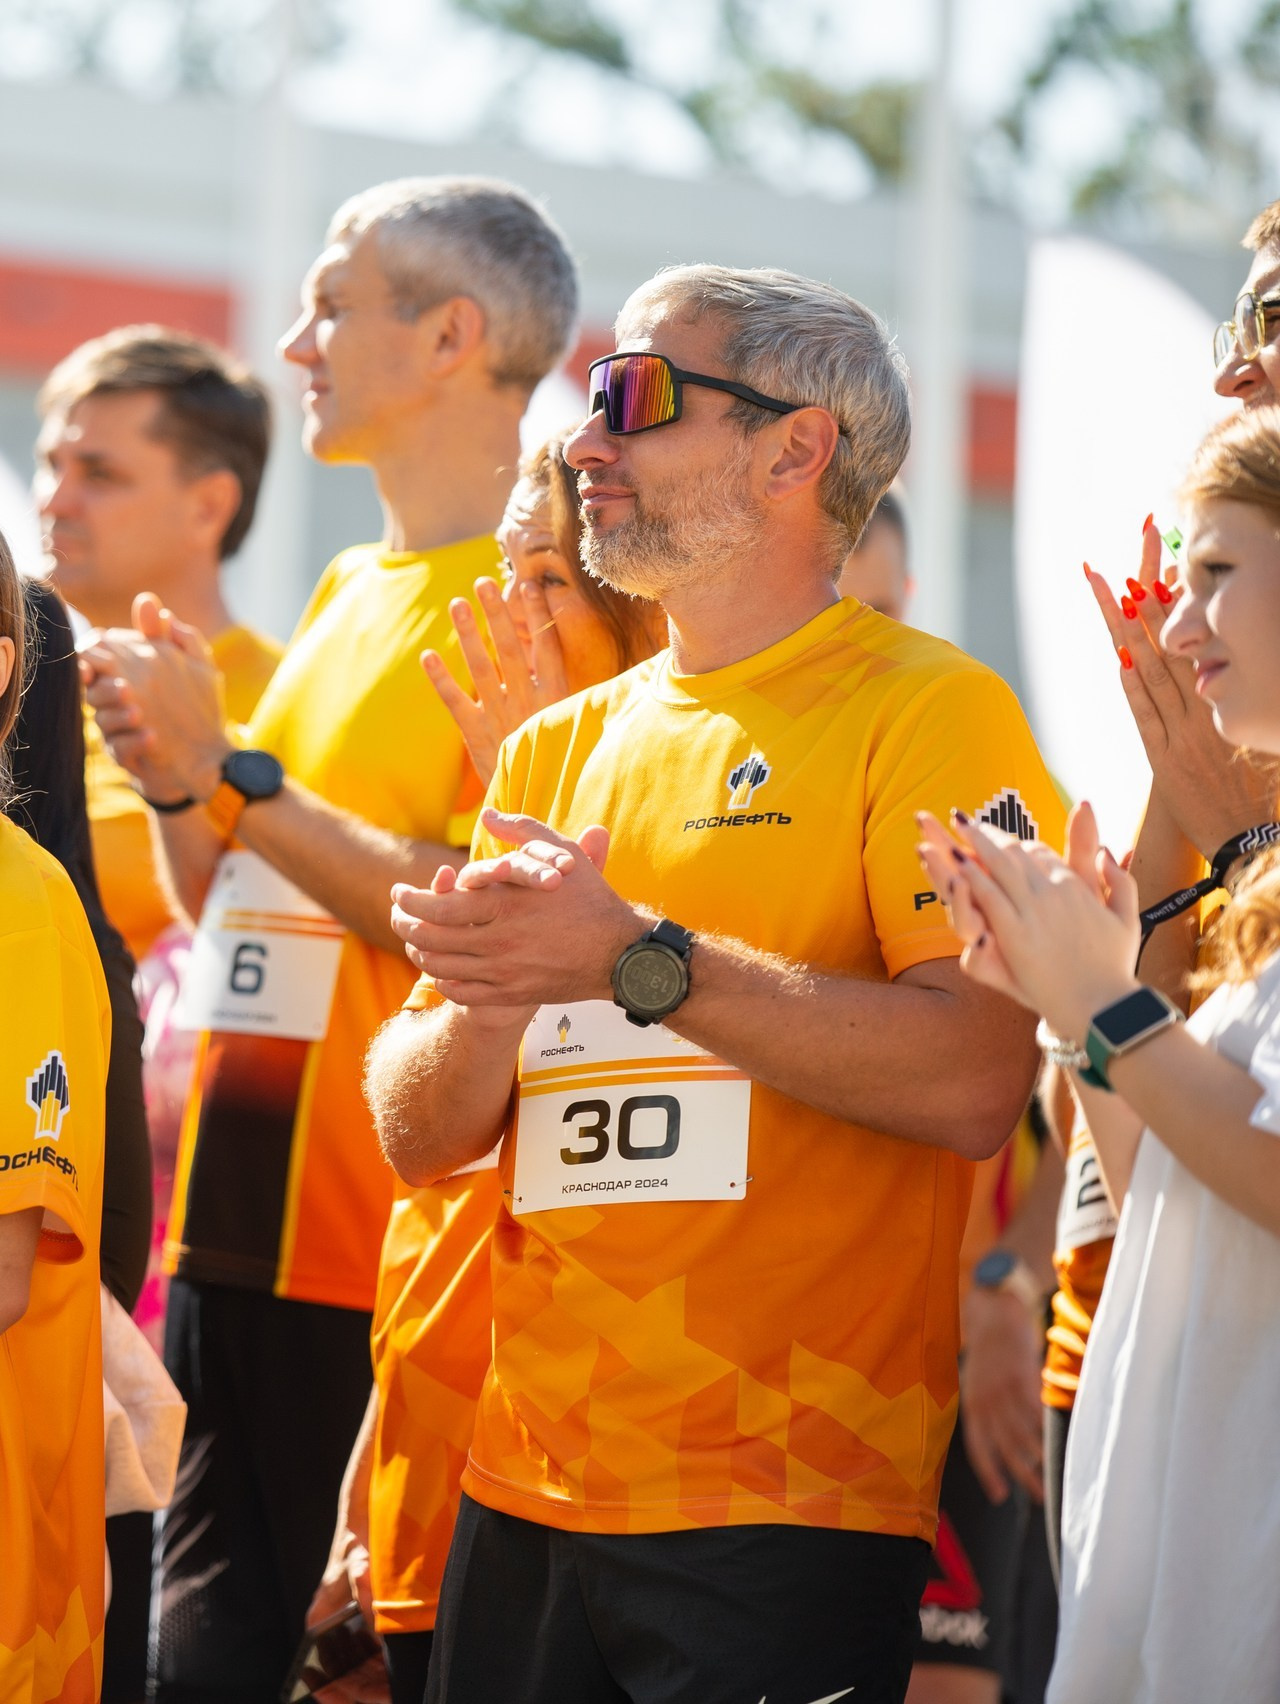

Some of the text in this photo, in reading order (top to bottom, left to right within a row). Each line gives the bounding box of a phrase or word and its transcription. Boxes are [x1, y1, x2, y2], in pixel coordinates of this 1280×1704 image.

[683, 812, 792, 832] РОСНЕФТЬ
[229, 941, 268, 996] 6
[540, 1044, 585, 1058] РОСНЕФТЬ
[559, 1094, 682, 1166] 30
[561, 1178, 669, 1194] КРАСНОДАР 2024
